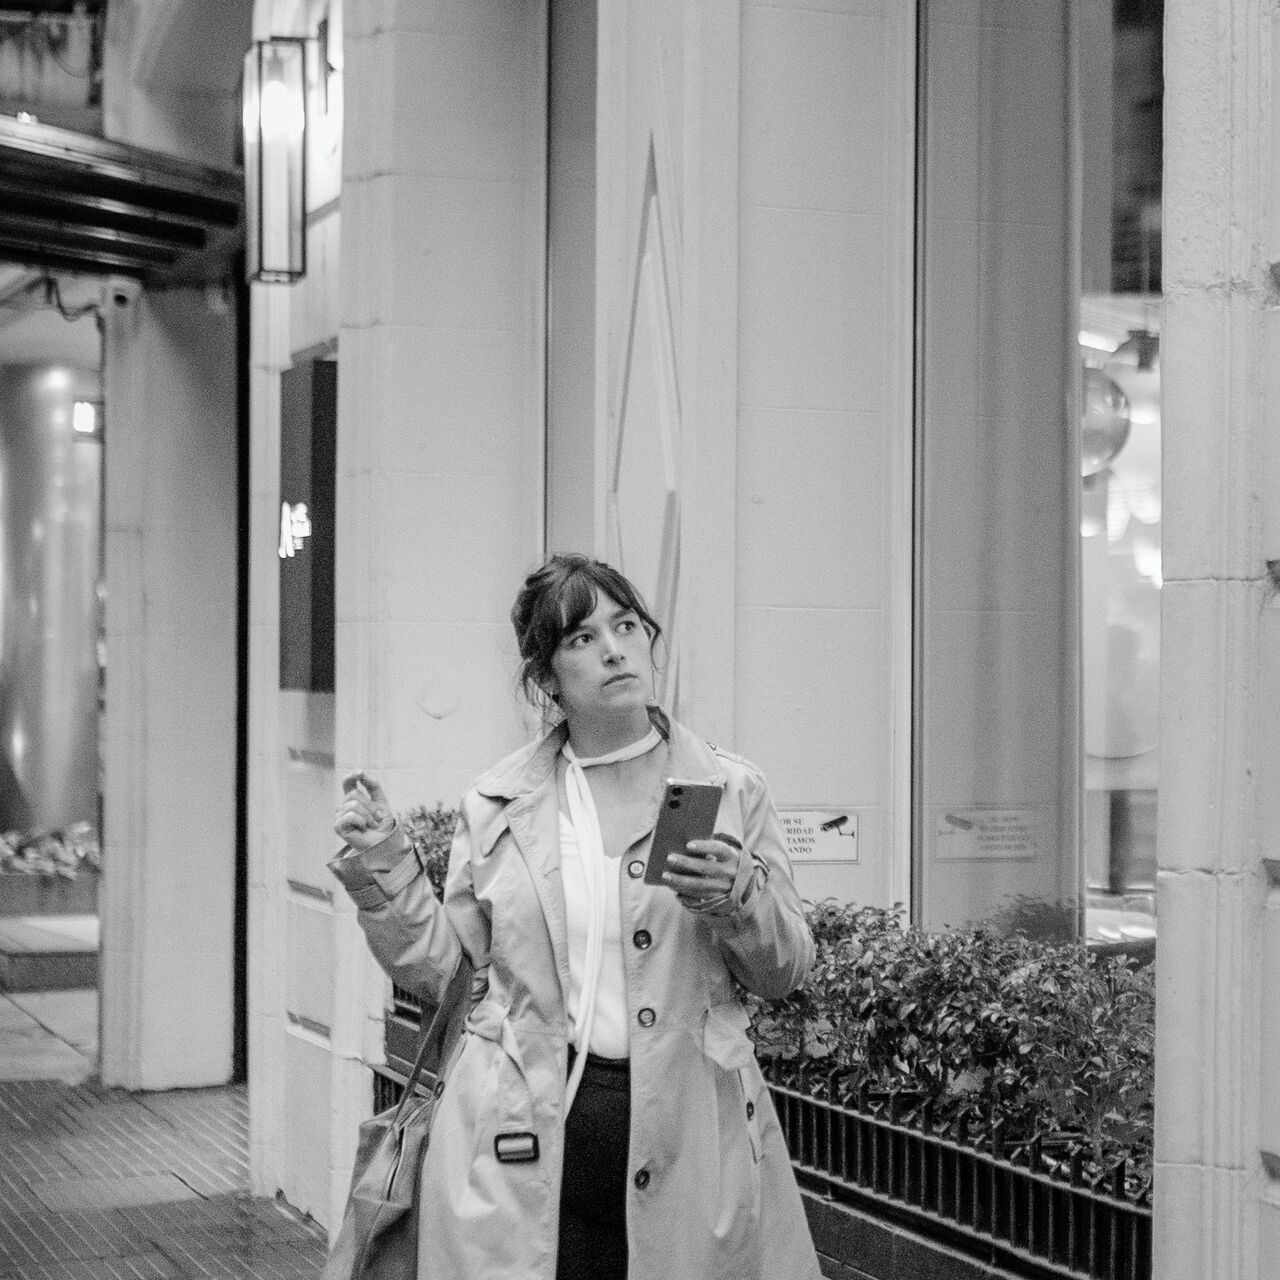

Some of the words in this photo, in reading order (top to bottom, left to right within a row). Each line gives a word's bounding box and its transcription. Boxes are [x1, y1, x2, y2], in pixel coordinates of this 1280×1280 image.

[785, 827, 814, 835] RIDAD
[786, 837, 816, 845] TAMOS
[788, 846, 813, 854] ANDO
